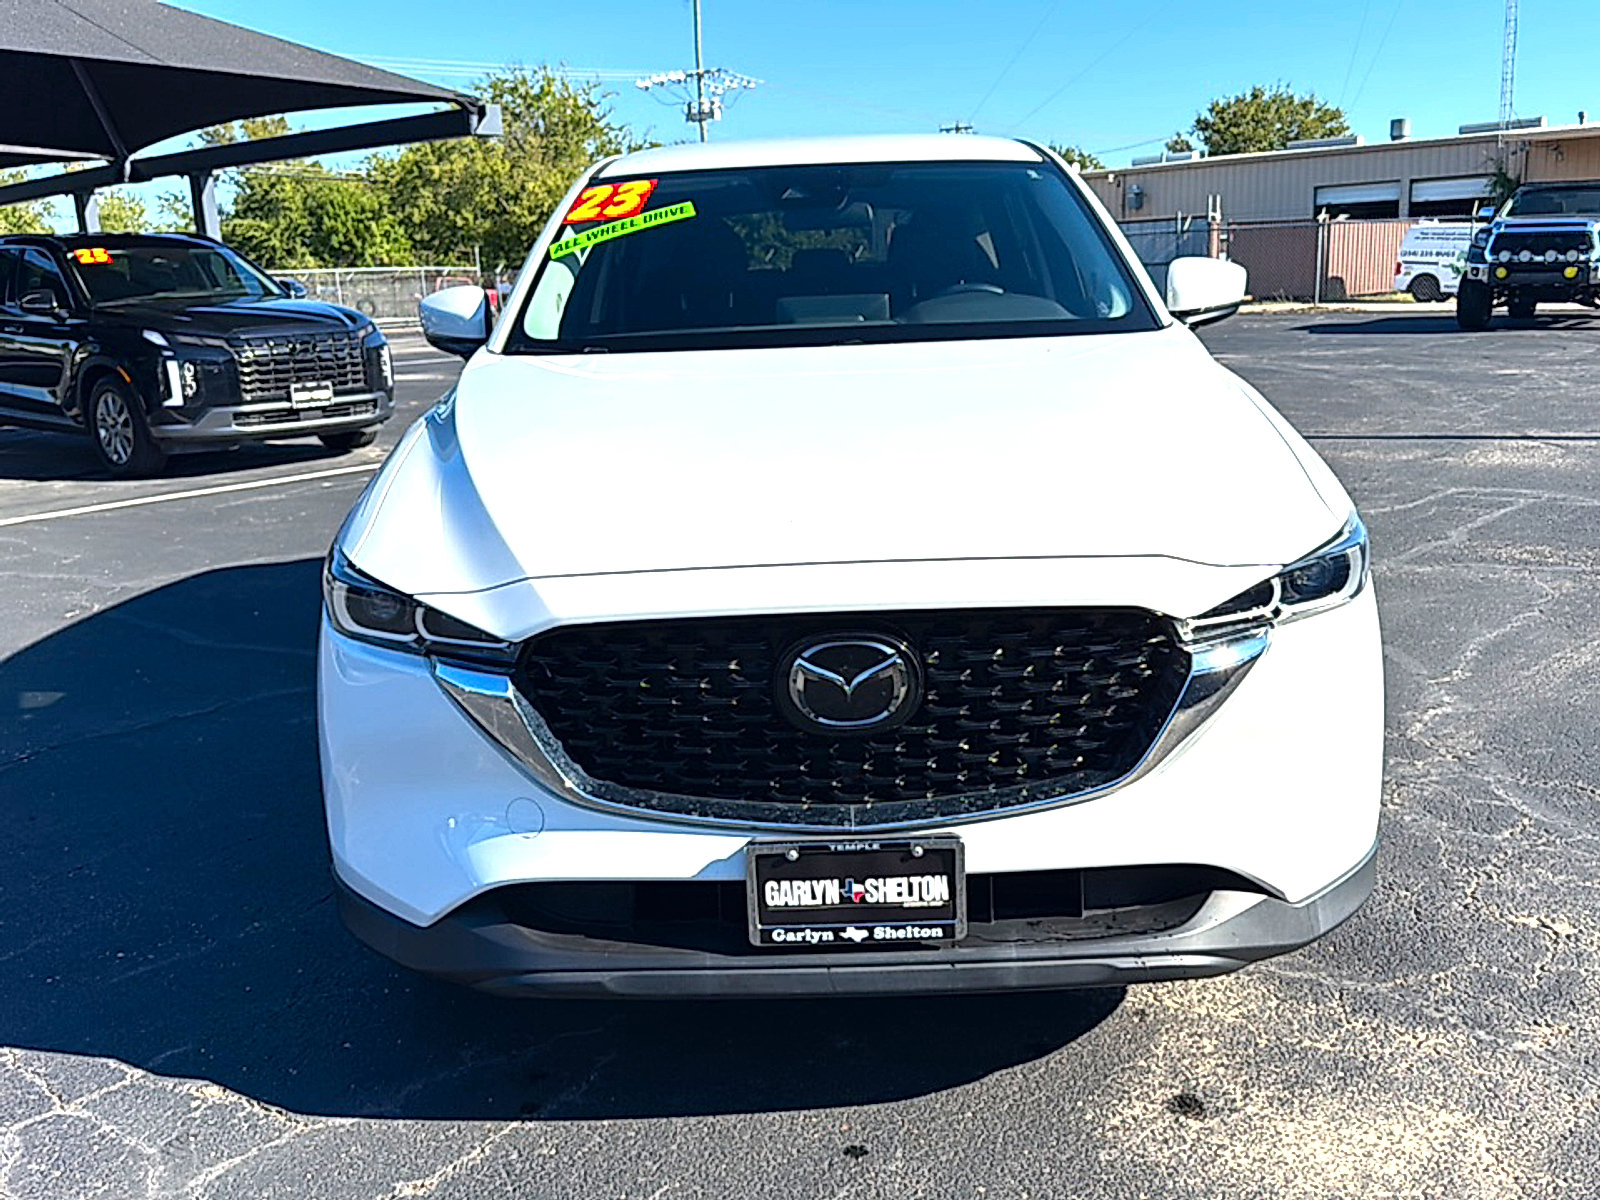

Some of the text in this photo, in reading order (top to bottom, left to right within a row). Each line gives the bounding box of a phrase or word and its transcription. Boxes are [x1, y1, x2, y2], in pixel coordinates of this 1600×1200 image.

[566, 181, 651, 221] 23
[553, 205, 688, 254] ALL WHEEL DRIVE
[76, 248, 108, 264] 25
[829, 842, 880, 851] TEMPLE
[765, 875, 950, 907] GARLYN SHELTON
[771, 926, 944, 944] Garlyn Shelton
